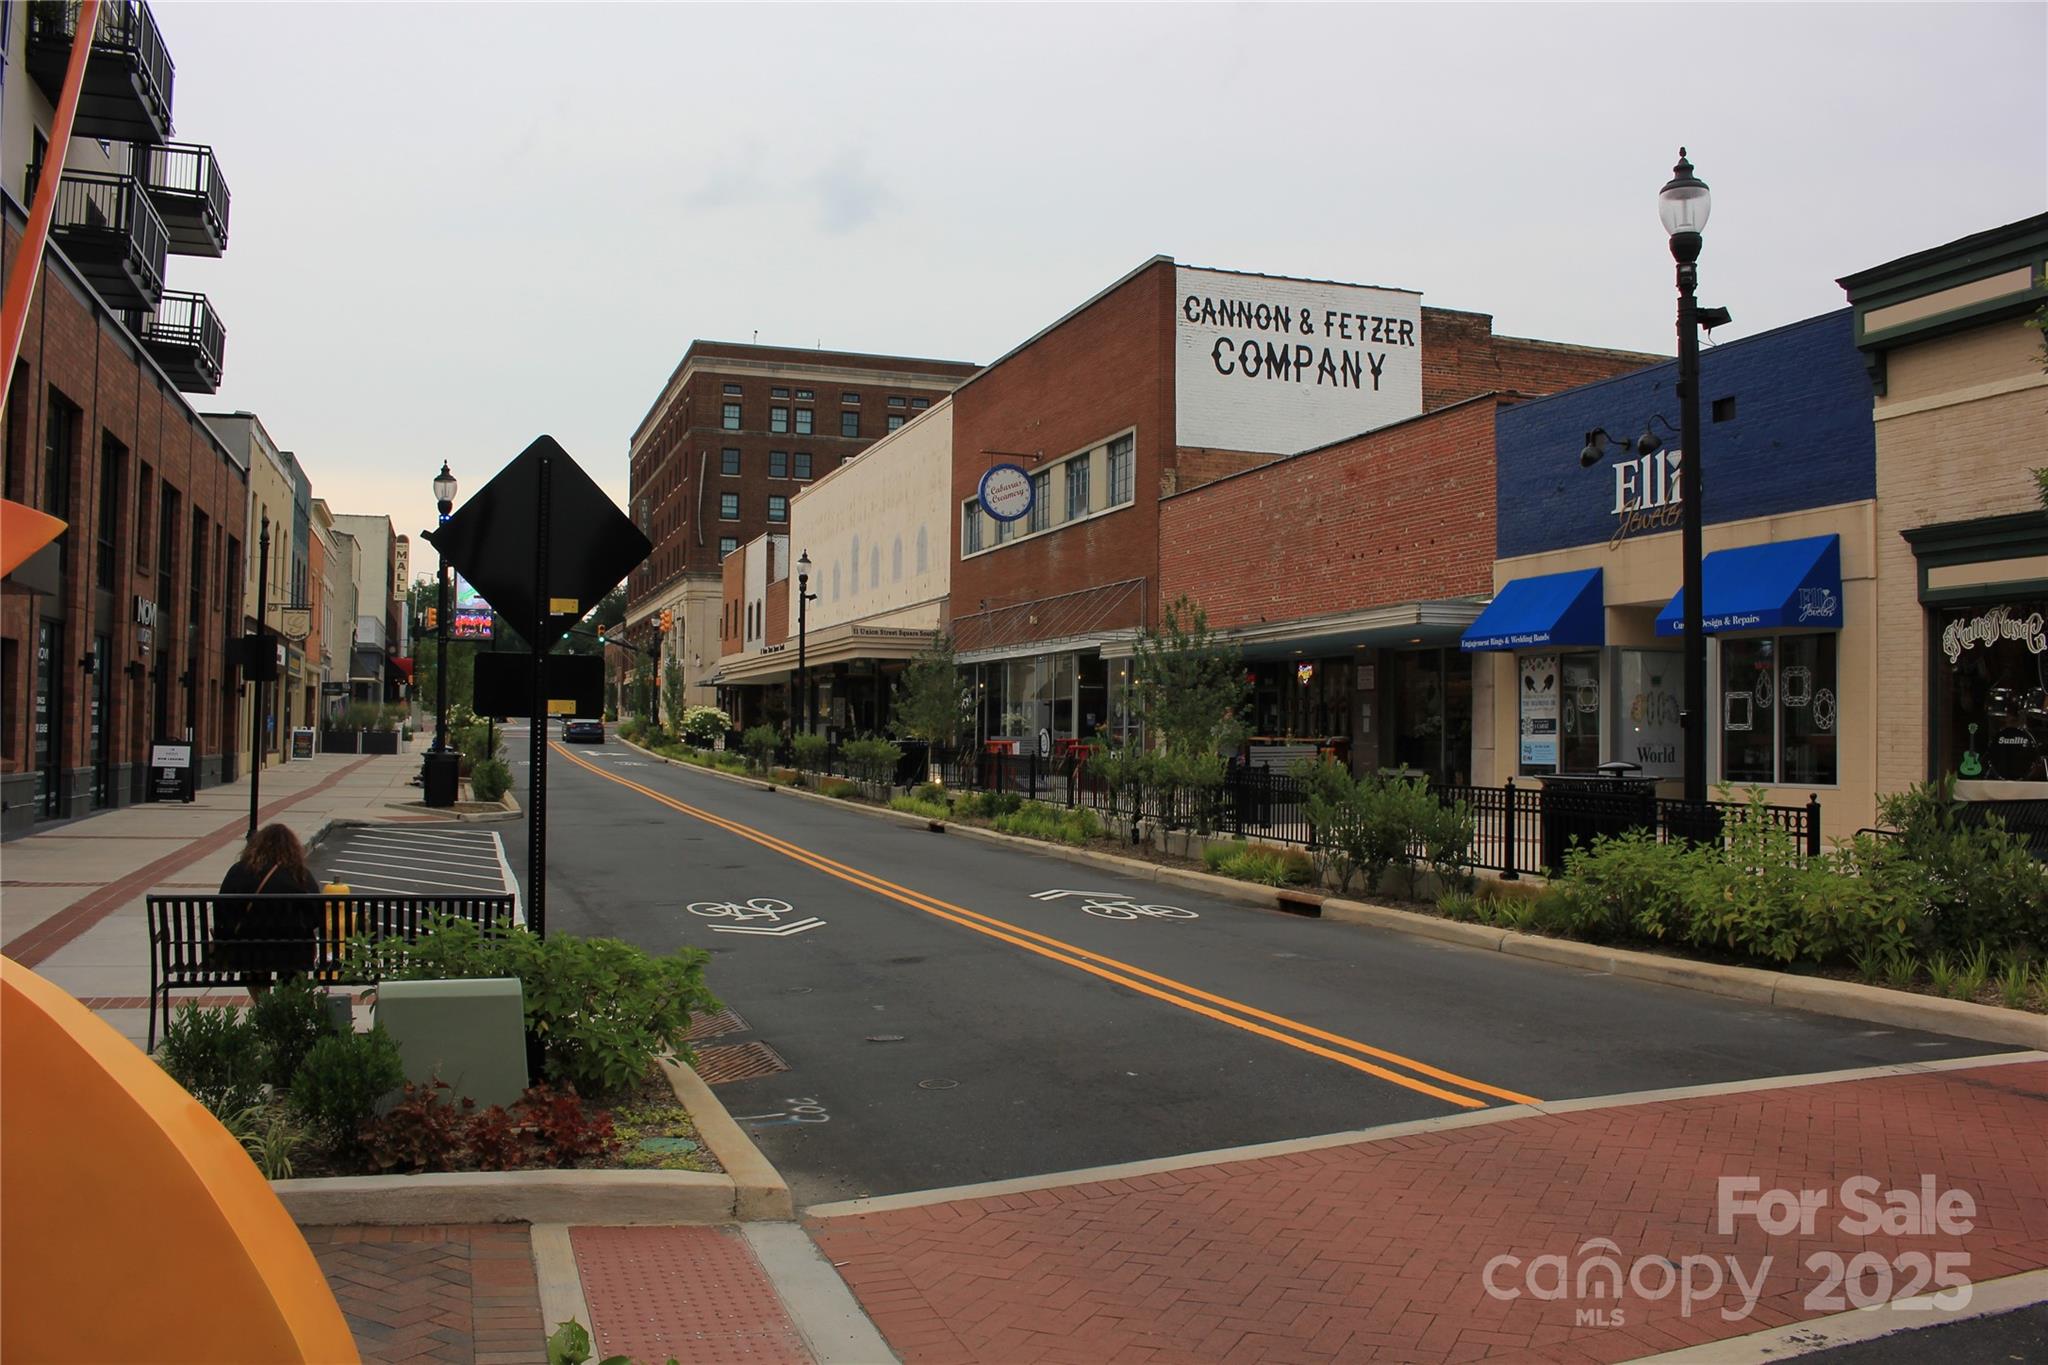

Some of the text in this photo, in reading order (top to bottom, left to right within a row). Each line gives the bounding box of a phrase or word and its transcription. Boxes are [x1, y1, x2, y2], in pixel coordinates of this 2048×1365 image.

[1183, 295, 1415, 347] CANNON & FETZER
[1211, 337, 1386, 391] COMPANY
[1611, 449, 1682, 515] Elli
[1608, 498, 1683, 552] Jeweler
[397, 551, 407, 593] MALL
[1510, 634, 1533, 643] Wedding
[1533, 632, 1550, 642] Bands
[1724, 616, 1731, 626] &
[1732, 614, 1760, 627] Repairs
[1943, 618, 1990, 664] Mullis
[1982, 606, 2029, 648] Music
[1637, 746, 1676, 763] World
[1998, 736, 2028, 744] Sunlite
